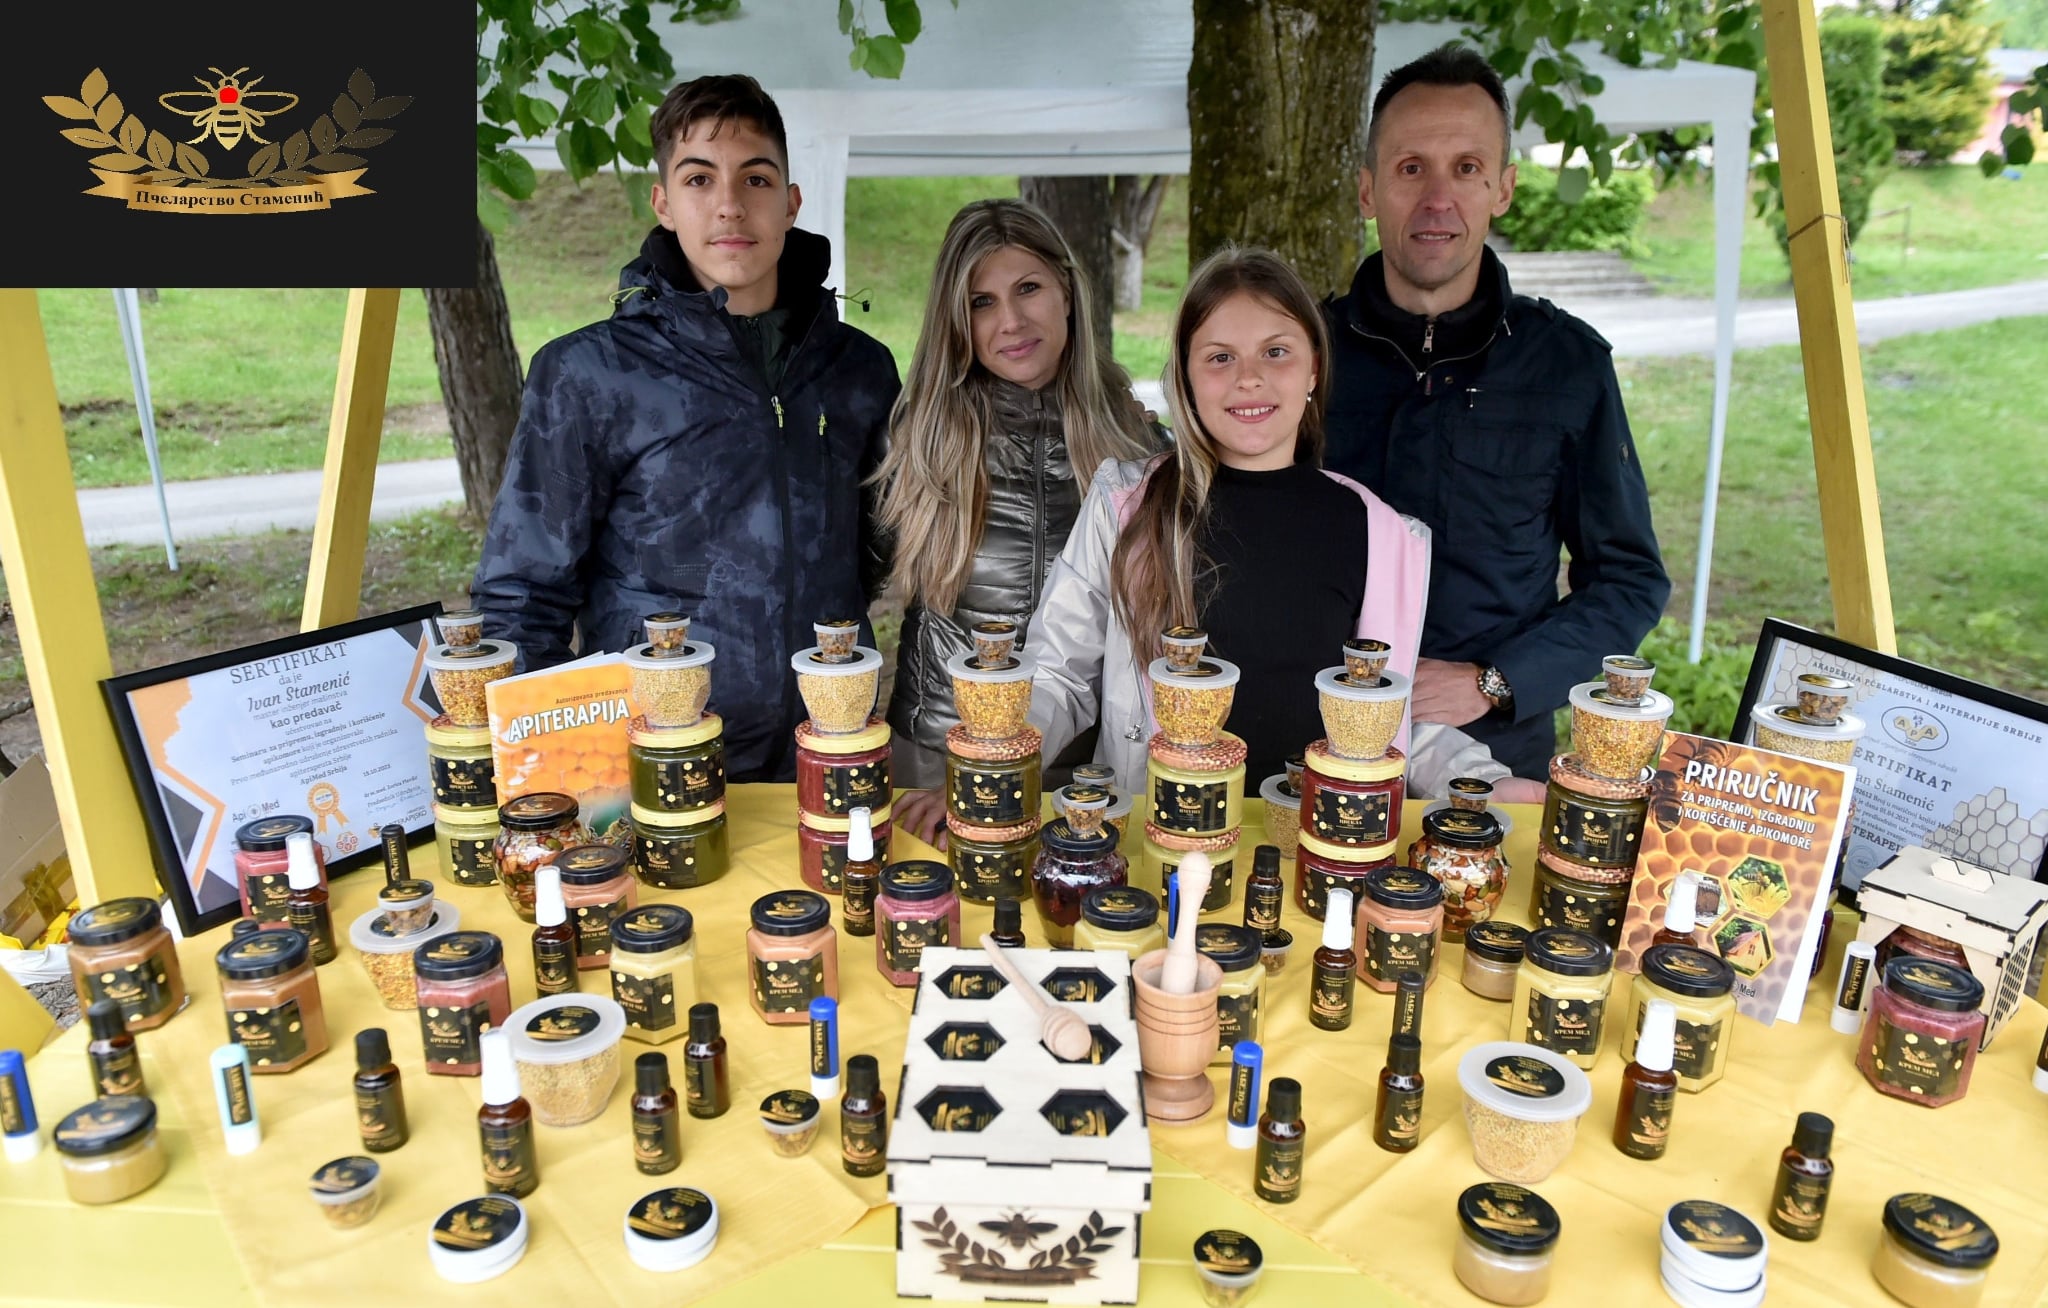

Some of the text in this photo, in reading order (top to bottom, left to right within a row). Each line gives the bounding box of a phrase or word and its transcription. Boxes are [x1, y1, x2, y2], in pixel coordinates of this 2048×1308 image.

[230, 641, 347, 684] SERTIFIKAT
[247, 671, 350, 712] Ivan Stamenić
[278, 672, 303, 685] da je
[555, 687, 628, 705] Autorizovana predavanja
[1812, 661, 1861, 683] AKADEMIJA
[1865, 678, 1923, 704] PČELARSTVA
[1933, 702, 1999, 729] APITERAPIJE
[2002, 725, 2043, 744] SRBIJE
[270, 701, 342, 729] kao predavač
[509, 697, 630, 742] APITERAPIJA
[231, 748, 267, 763] Seminaru
[277, 734, 314, 751] pripremu,
[314, 724, 347, 738] izgradnju
[352, 712, 386, 727] korišćenje
[263, 749, 301, 764] apikomore
[322, 729, 364, 745] organizovalo
[374, 728, 398, 739] radnika
[300, 765, 347, 785] ApiMed Srbija
[1854, 746, 1952, 793] ERTIFIKAT
[1684, 760, 1819, 815] PRIRUČNIK
[1872, 795, 1886, 806] Broj
[1874, 777, 1936, 812] Stamenić
[232, 799, 280, 823] Api Med
[1681, 790, 1815, 834] ZA PRIPREMU, IZGRADNJU
[1677, 806, 1812, 850] I KORIŠĆENJE APIKOMORE
[1405, 959, 1420, 967] МЕД
[1740, 984, 1756, 997] Med
[1554, 1028, 1591, 1036] КРЕМ МЕД
[1898, 1061, 1940, 1078] КРЕМ МЕД
